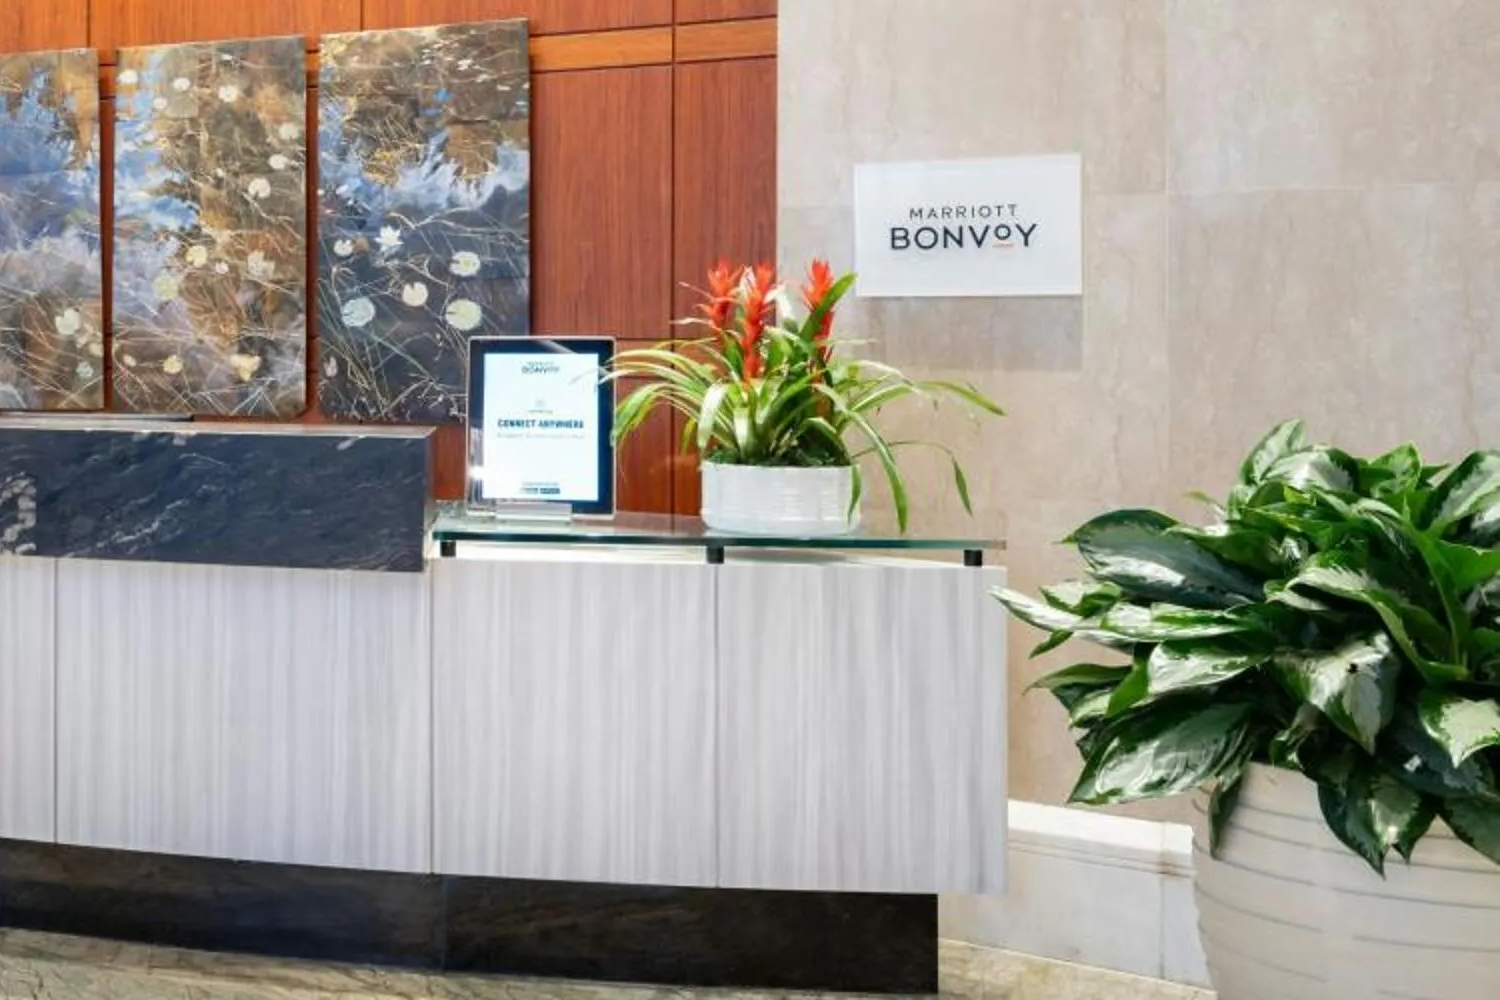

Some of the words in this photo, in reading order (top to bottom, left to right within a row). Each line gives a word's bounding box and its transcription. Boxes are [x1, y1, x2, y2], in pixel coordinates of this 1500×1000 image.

[909, 203, 1018, 220] MARRIOTT
[890, 223, 1037, 250] BONVOY
[497, 419, 536, 429] CONNECT
[538, 419, 584, 429] ANYWHERE
